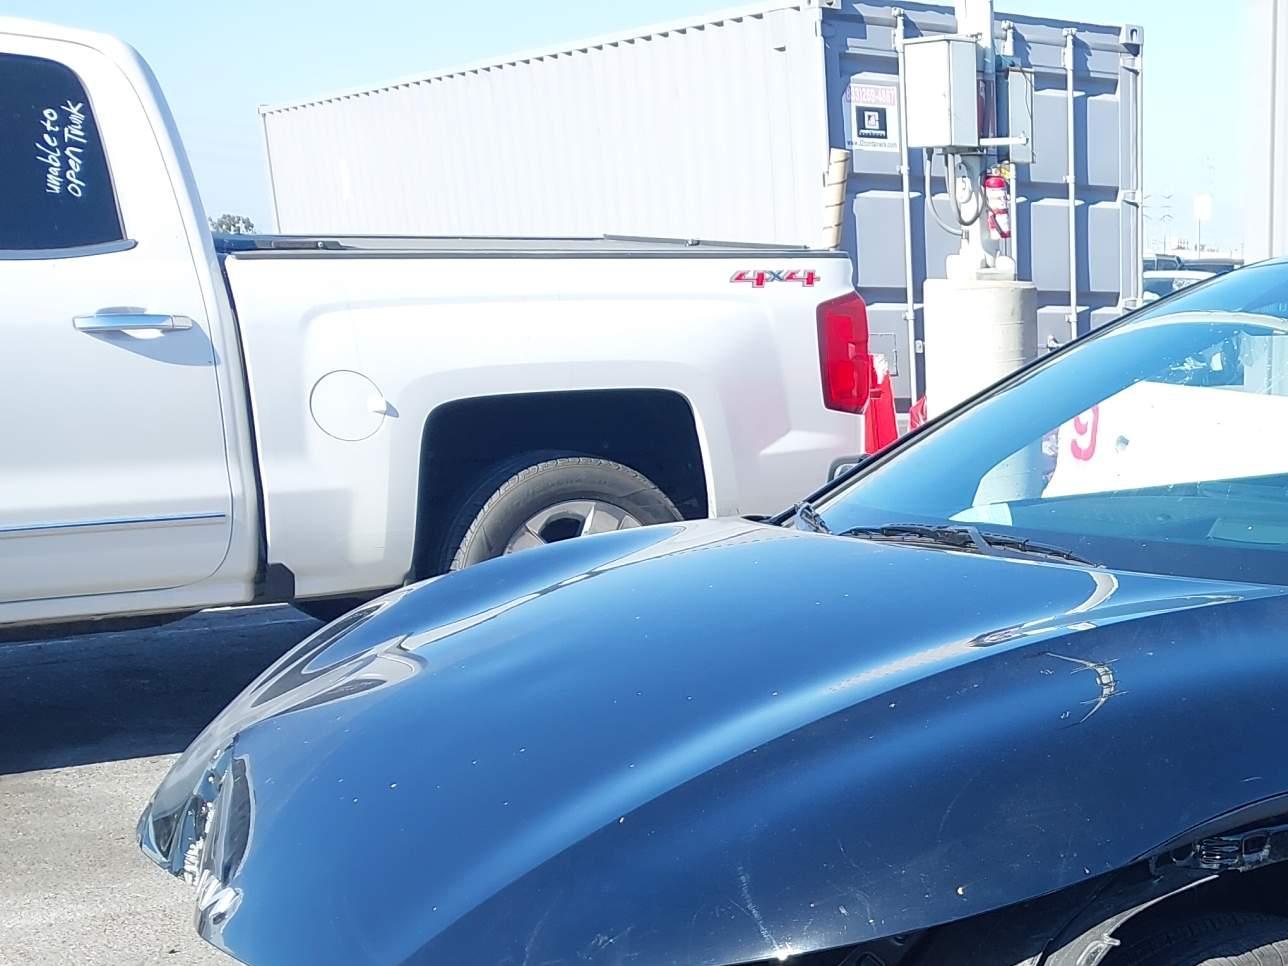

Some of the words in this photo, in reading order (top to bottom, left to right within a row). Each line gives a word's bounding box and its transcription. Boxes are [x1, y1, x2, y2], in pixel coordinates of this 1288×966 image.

[40, 108, 60, 132] to
[36, 133, 63, 194] unable
[64, 146, 86, 198] open
